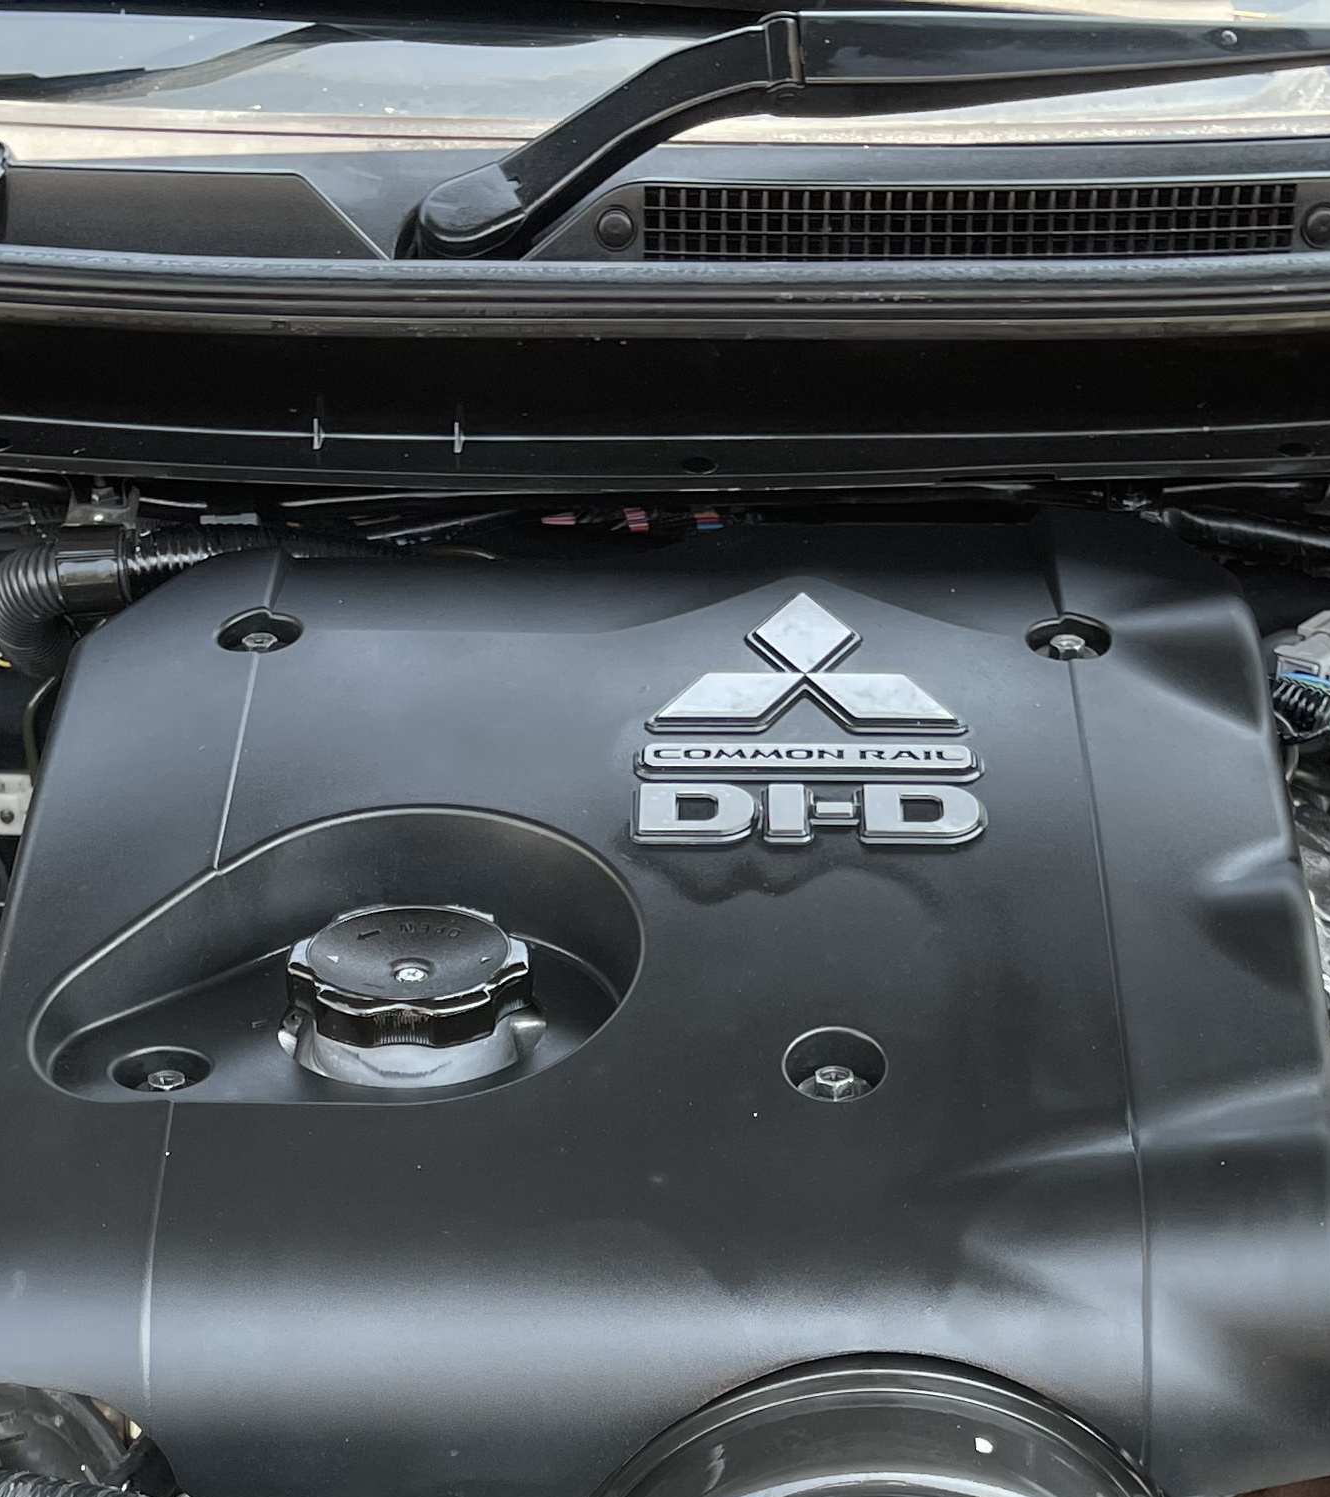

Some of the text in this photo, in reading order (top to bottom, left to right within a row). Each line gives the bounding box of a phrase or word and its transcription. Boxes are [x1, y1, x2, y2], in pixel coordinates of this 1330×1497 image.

[652, 747, 964, 763] COMMON RAIL
[631, 783, 987, 845] DI-D
[400, 922, 462, 940] OPEN
